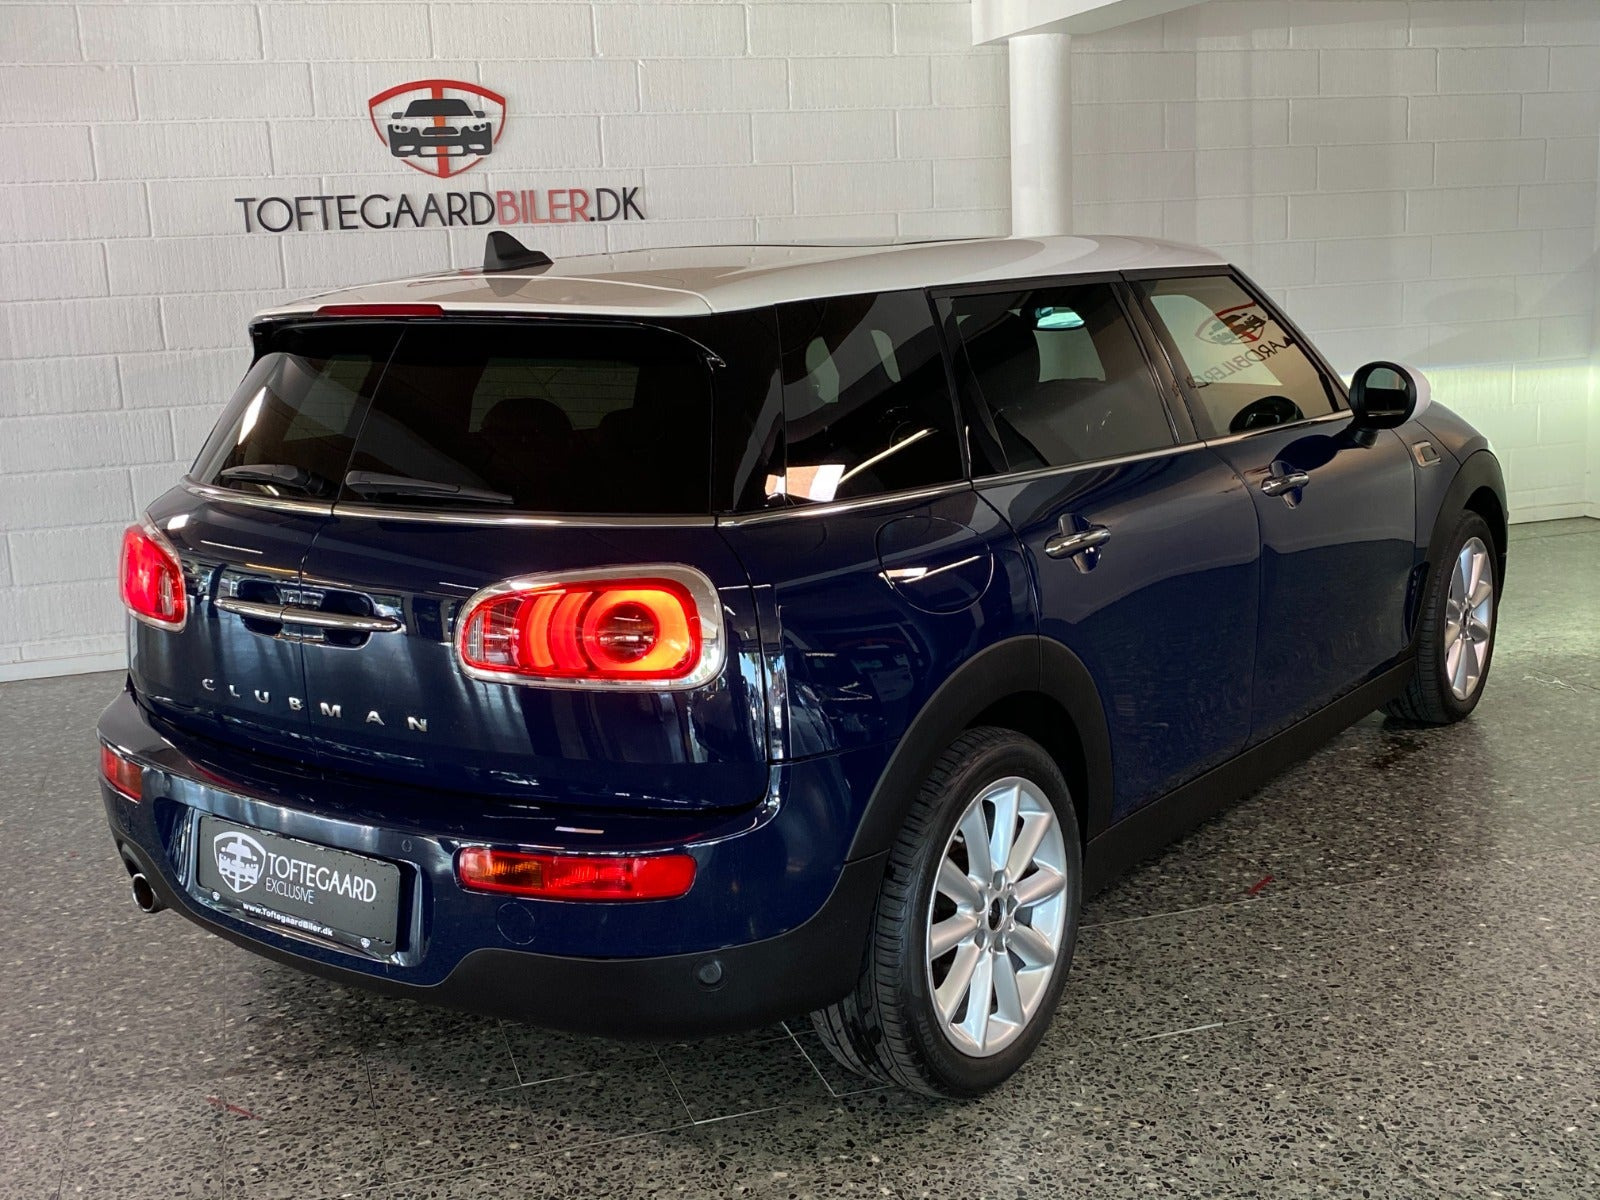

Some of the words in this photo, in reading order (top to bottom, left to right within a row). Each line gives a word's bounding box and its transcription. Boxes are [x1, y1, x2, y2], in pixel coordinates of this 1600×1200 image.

[235, 186, 646, 233] TOFTEGAARDBILER.DK
[201, 678, 429, 733] CLUBMAN
[265, 877, 315, 905] EXCLUSIVE
[267, 852, 377, 903] TOFTEGAARD
[242, 902, 333, 937] www.ToftegaardBiler.dk
